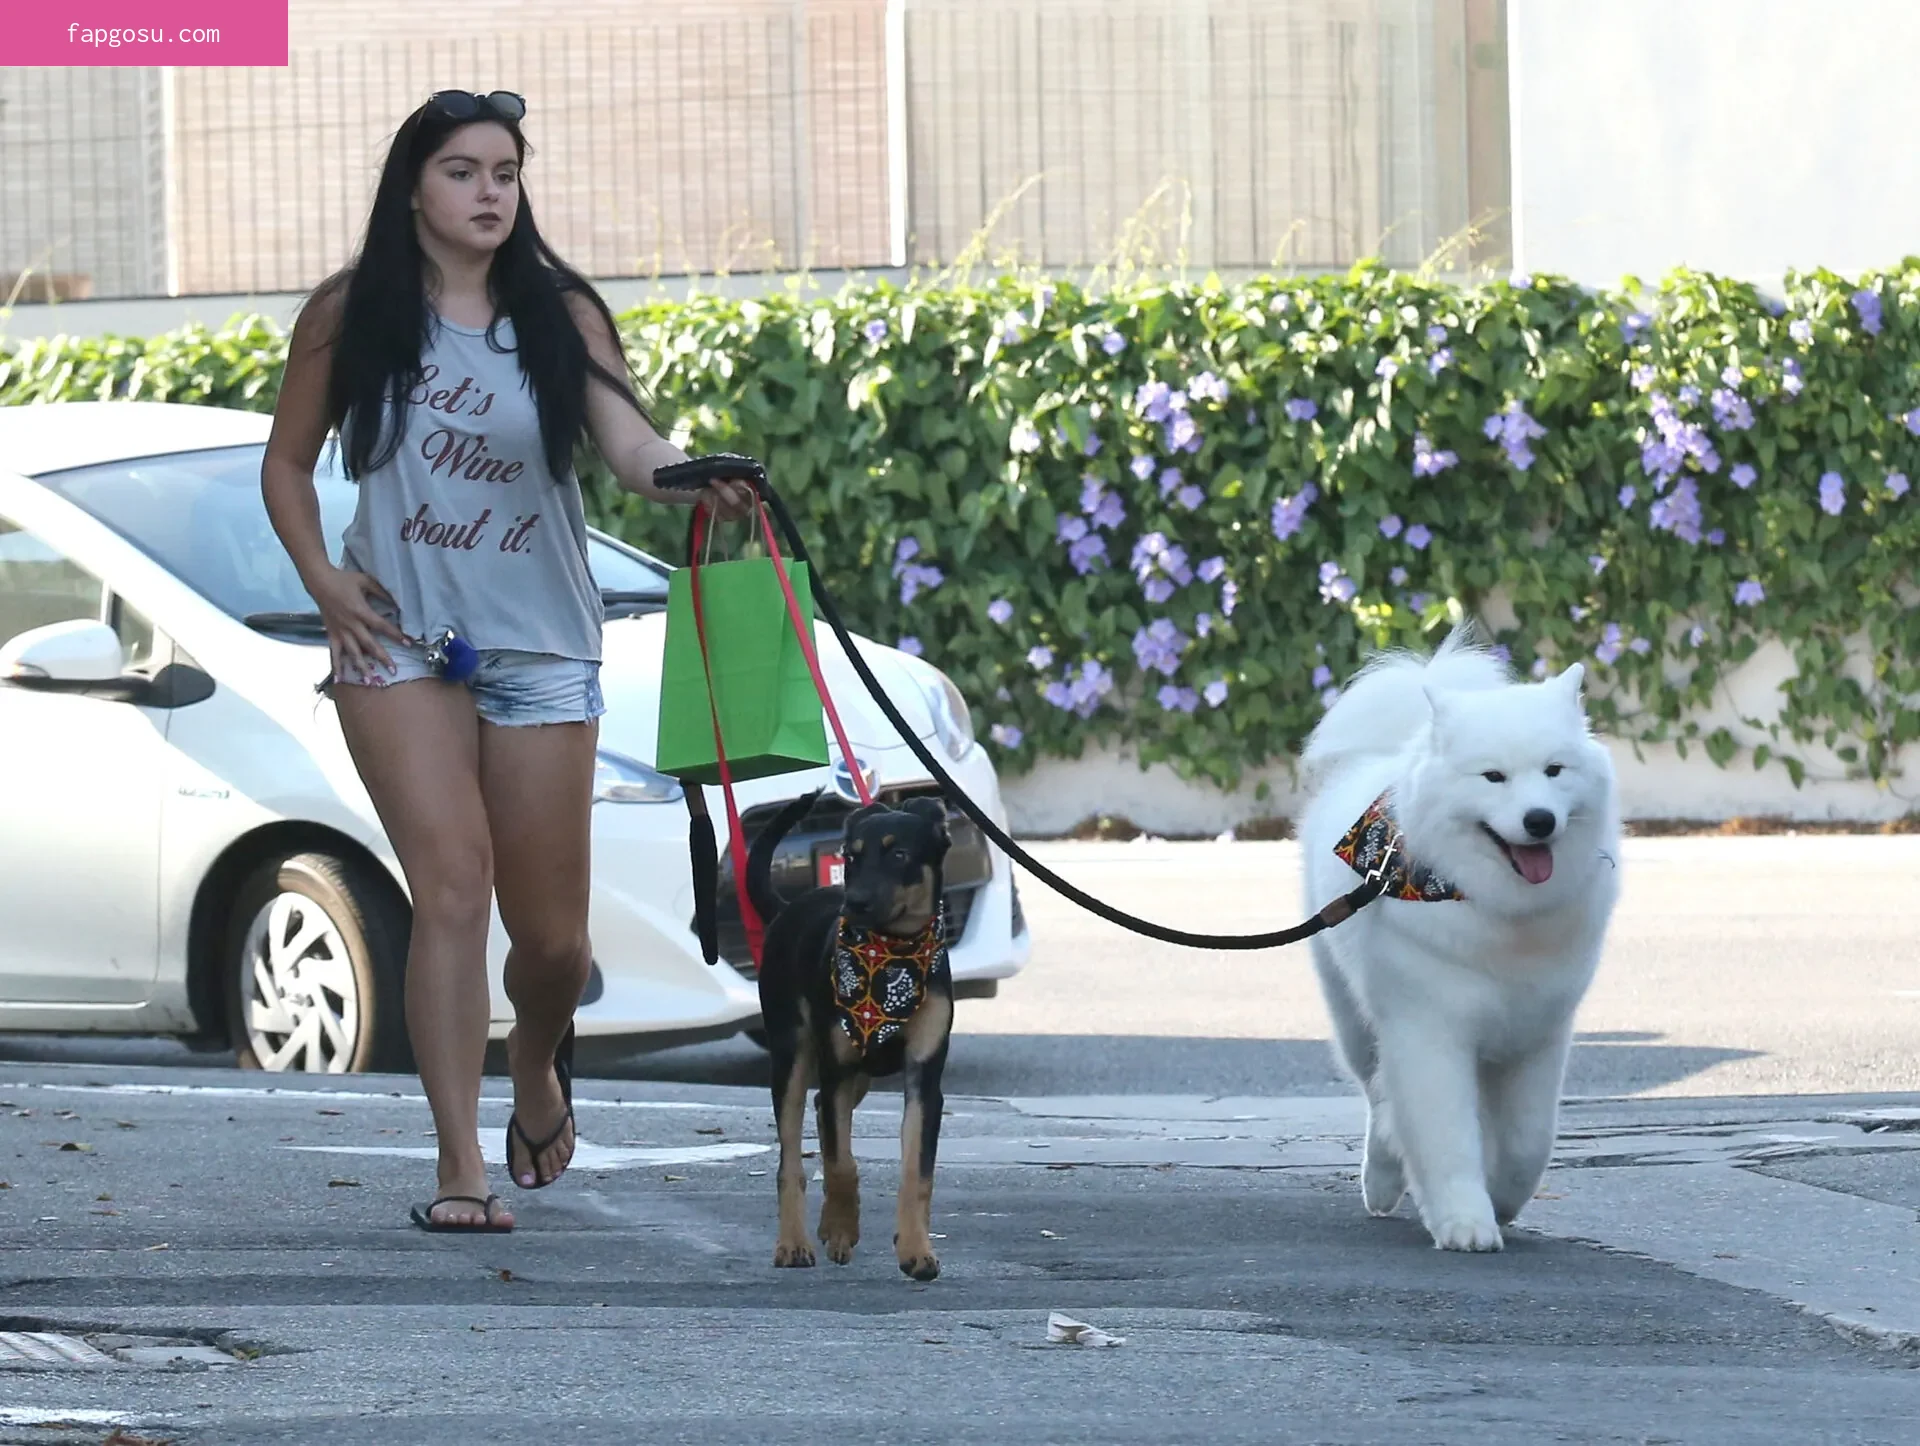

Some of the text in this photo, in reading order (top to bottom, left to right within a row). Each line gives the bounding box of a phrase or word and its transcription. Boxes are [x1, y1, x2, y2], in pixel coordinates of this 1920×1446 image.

[421, 429, 524, 483] Wine
[400, 503, 540, 553] about it.
